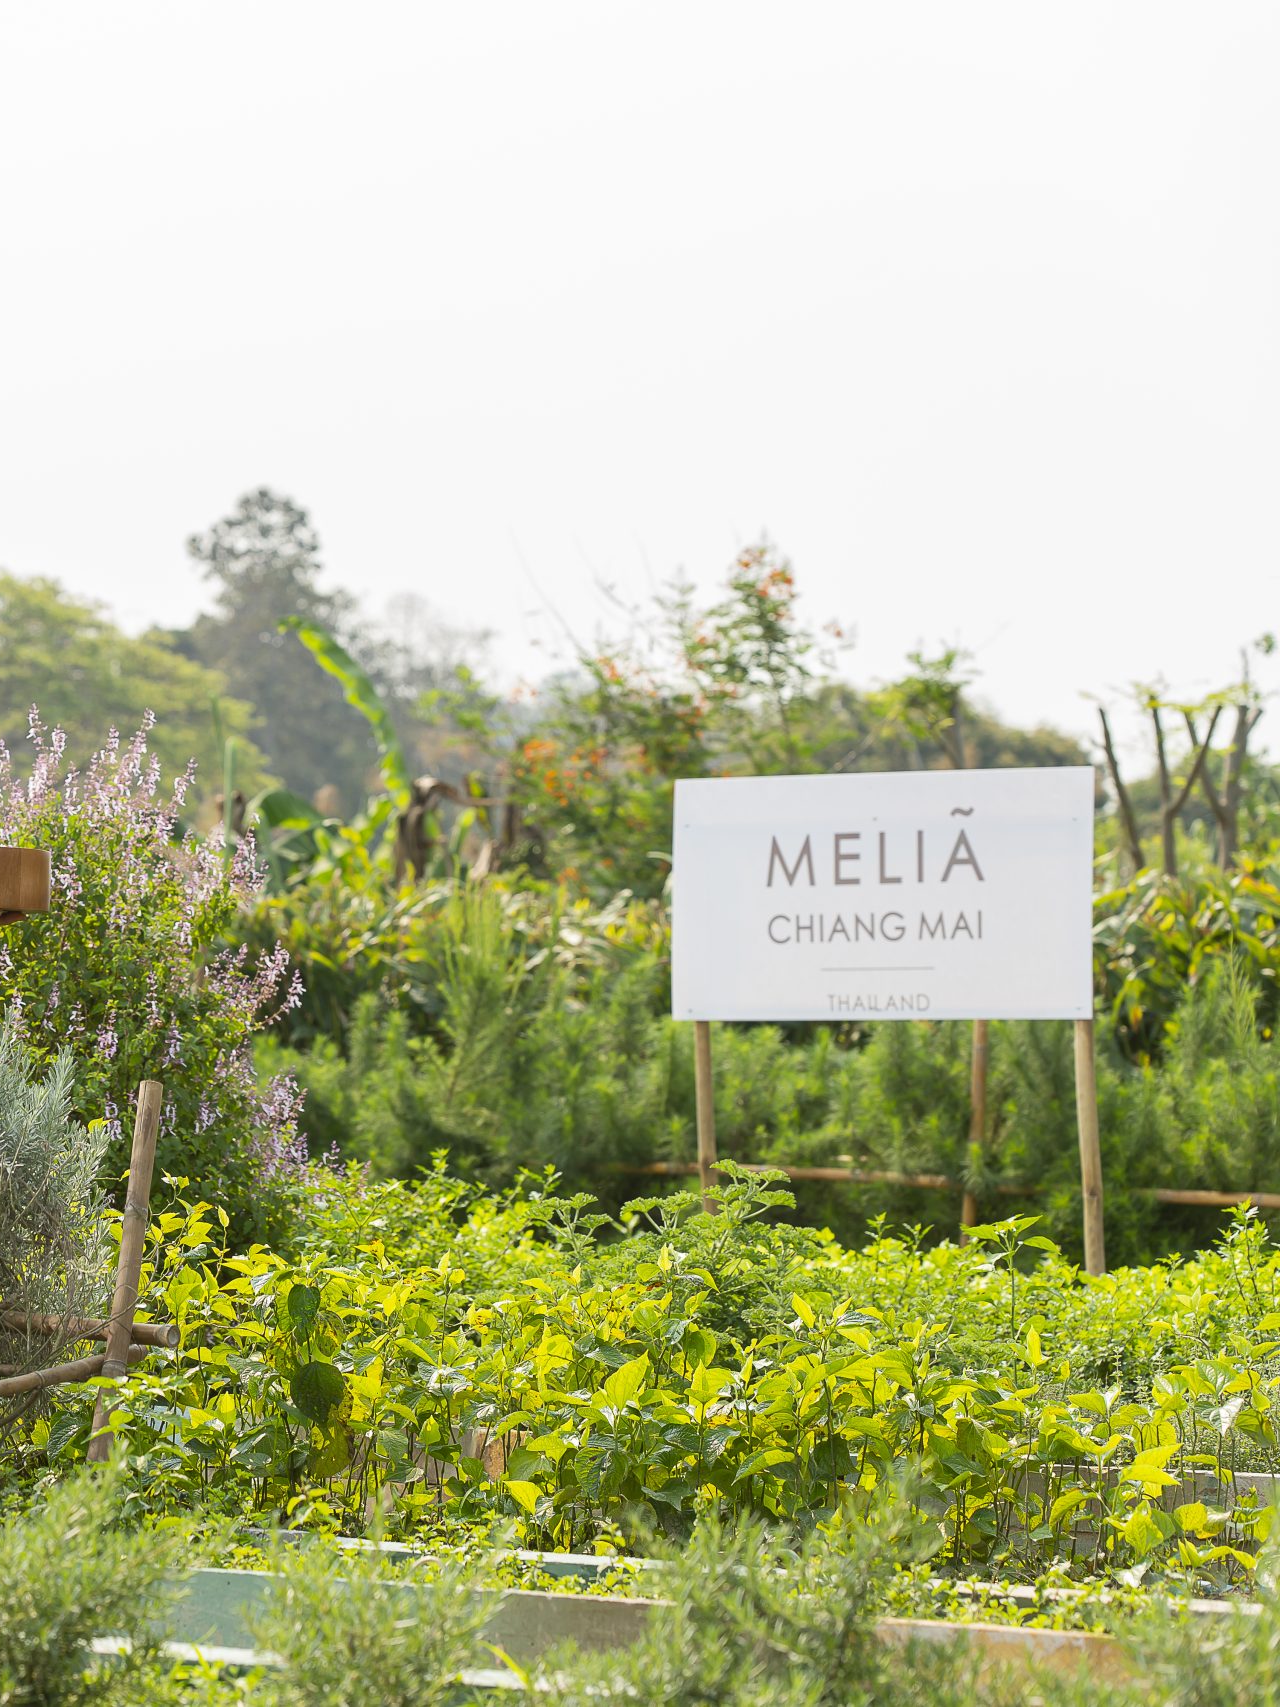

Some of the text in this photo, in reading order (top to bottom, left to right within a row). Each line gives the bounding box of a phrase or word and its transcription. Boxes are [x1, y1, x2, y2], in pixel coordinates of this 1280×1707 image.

[767, 910, 984, 944] CHIANG MAI
[827, 994, 931, 1013] THAILAND
